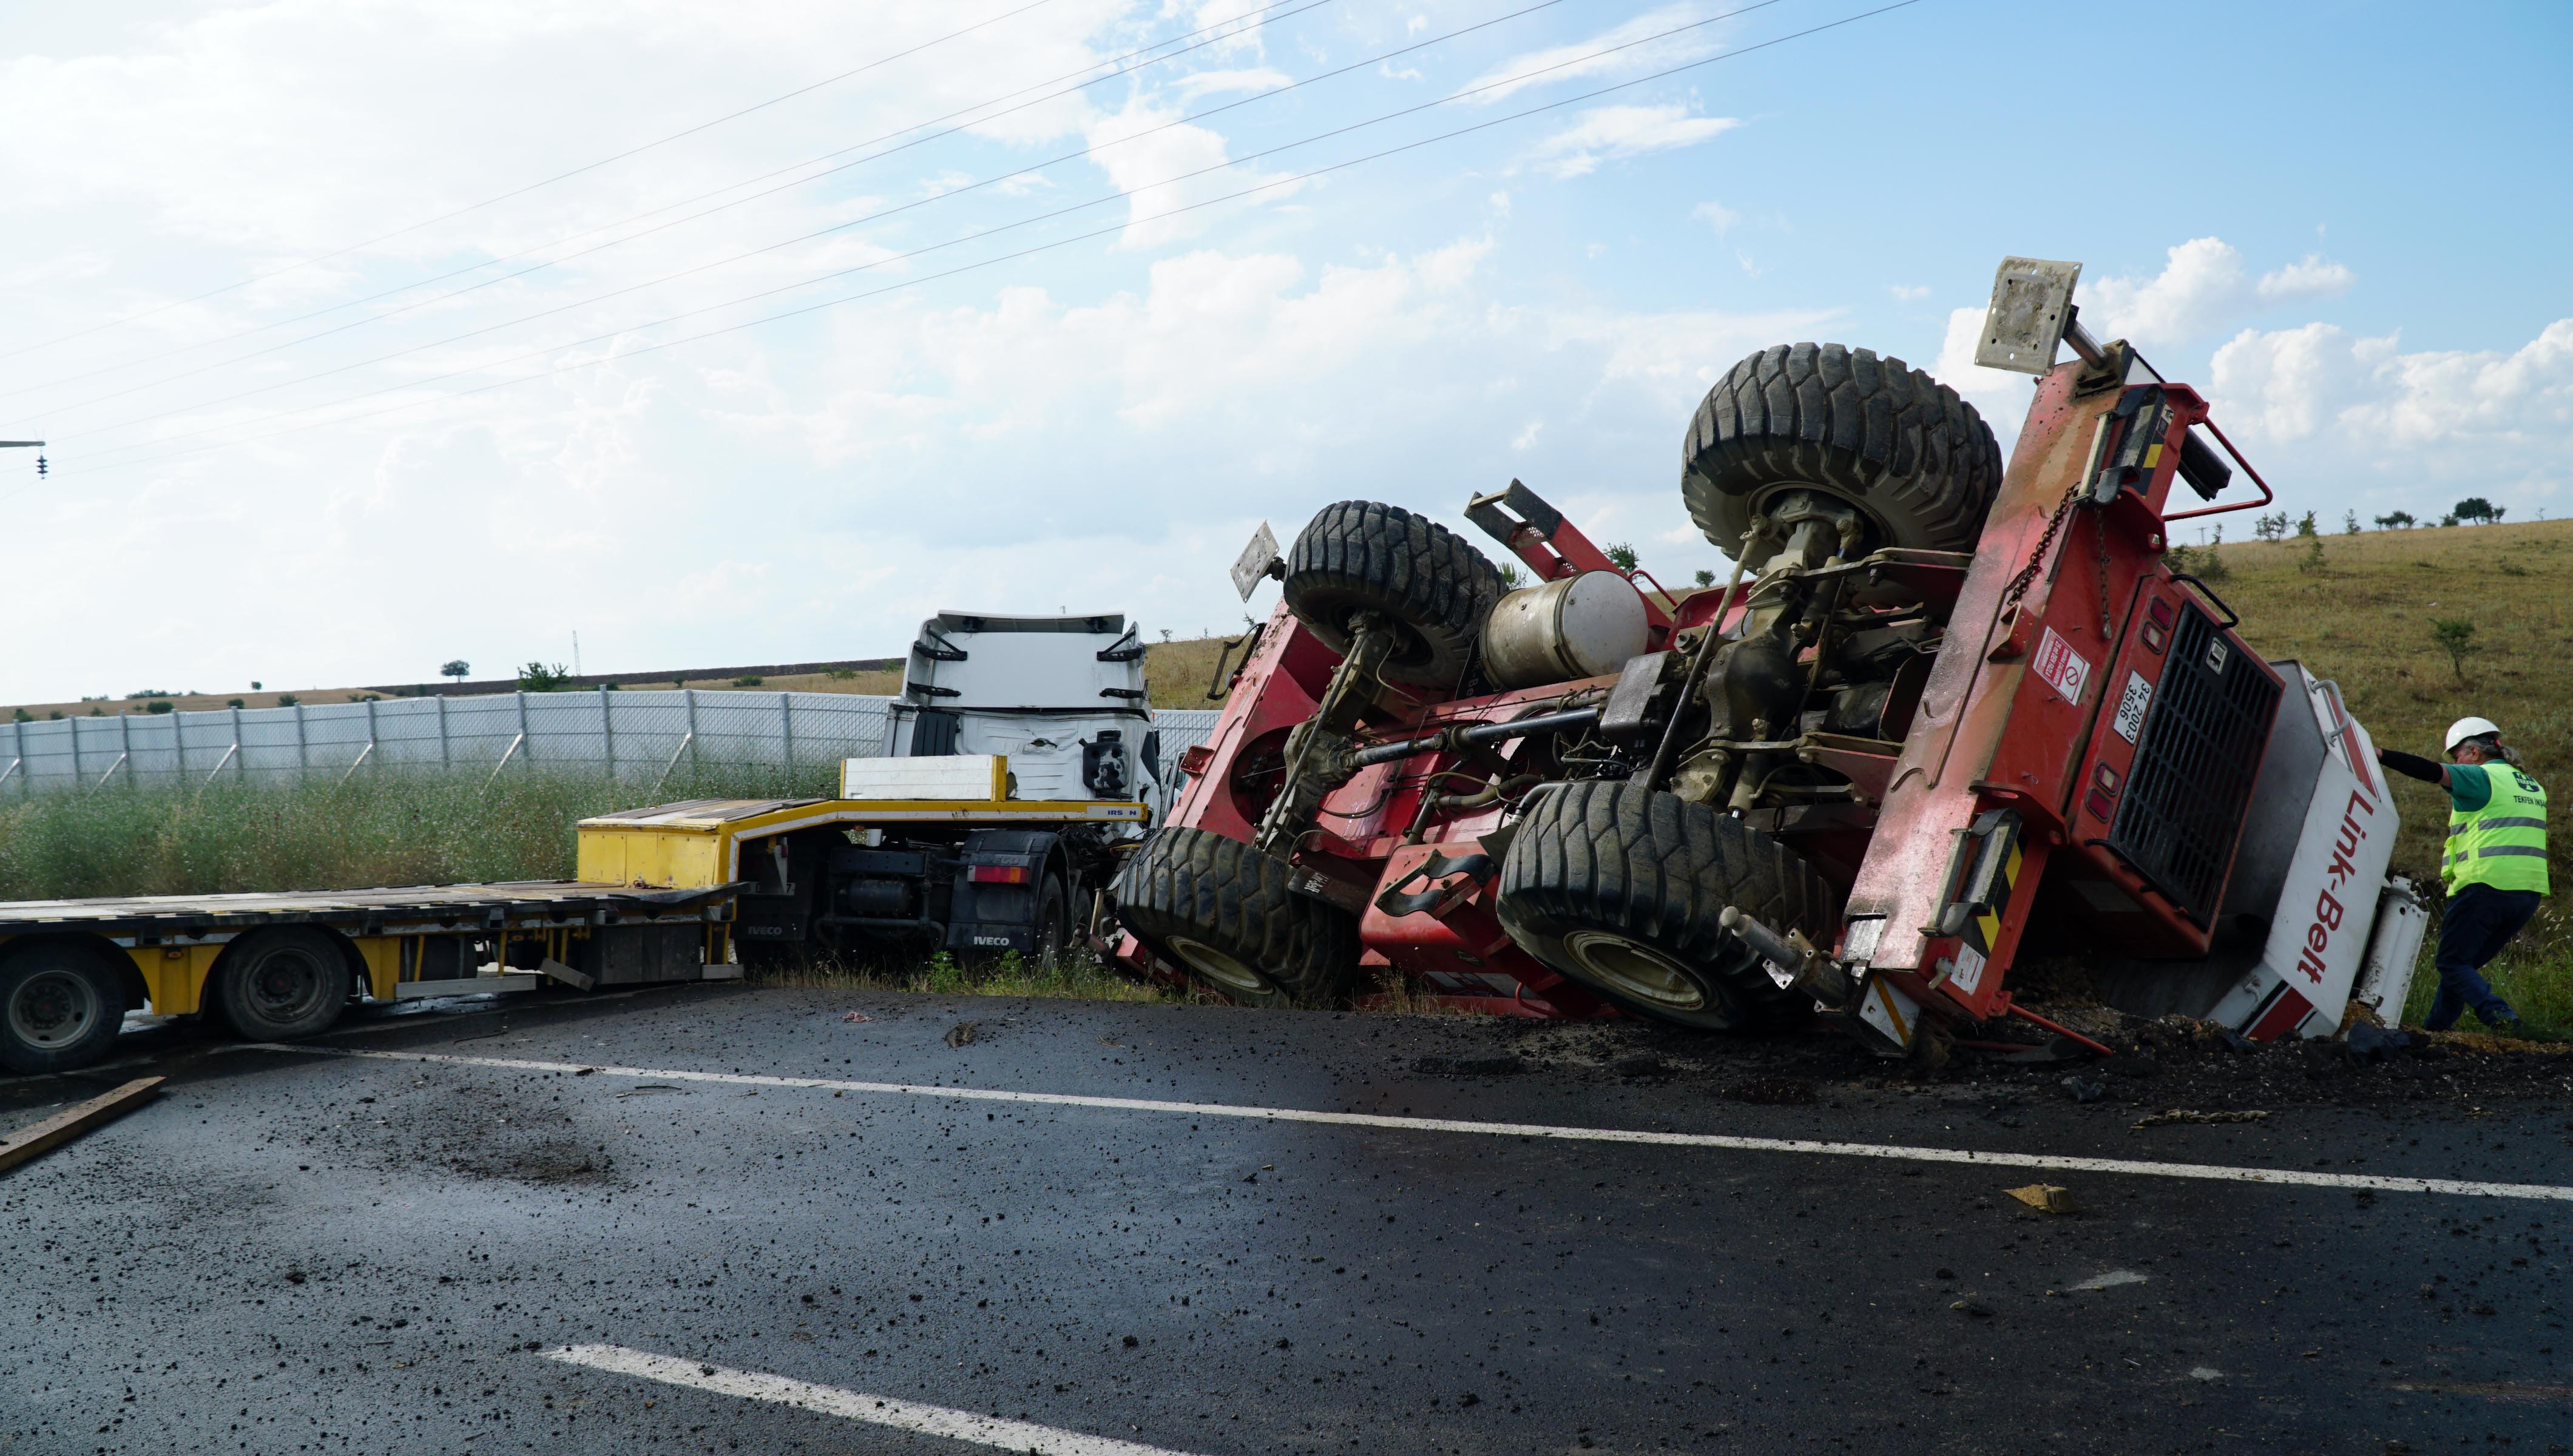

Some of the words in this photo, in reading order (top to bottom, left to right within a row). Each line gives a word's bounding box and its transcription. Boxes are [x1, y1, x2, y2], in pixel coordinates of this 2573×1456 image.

[2049, 651, 2058, 665] DEN
[2044, 660, 2055, 678] FAZLA
[2139, 683, 2150, 702] 34
[2120, 684, 2137, 720] 3506
[2126, 704, 2142, 741] 2003
[2514, 795, 2534, 805] TEKFEN
[2297, 790, 2374, 985] Link-Belt
[748, 926, 782, 935] IVECO
[973, 936, 1010, 946] IVECO
